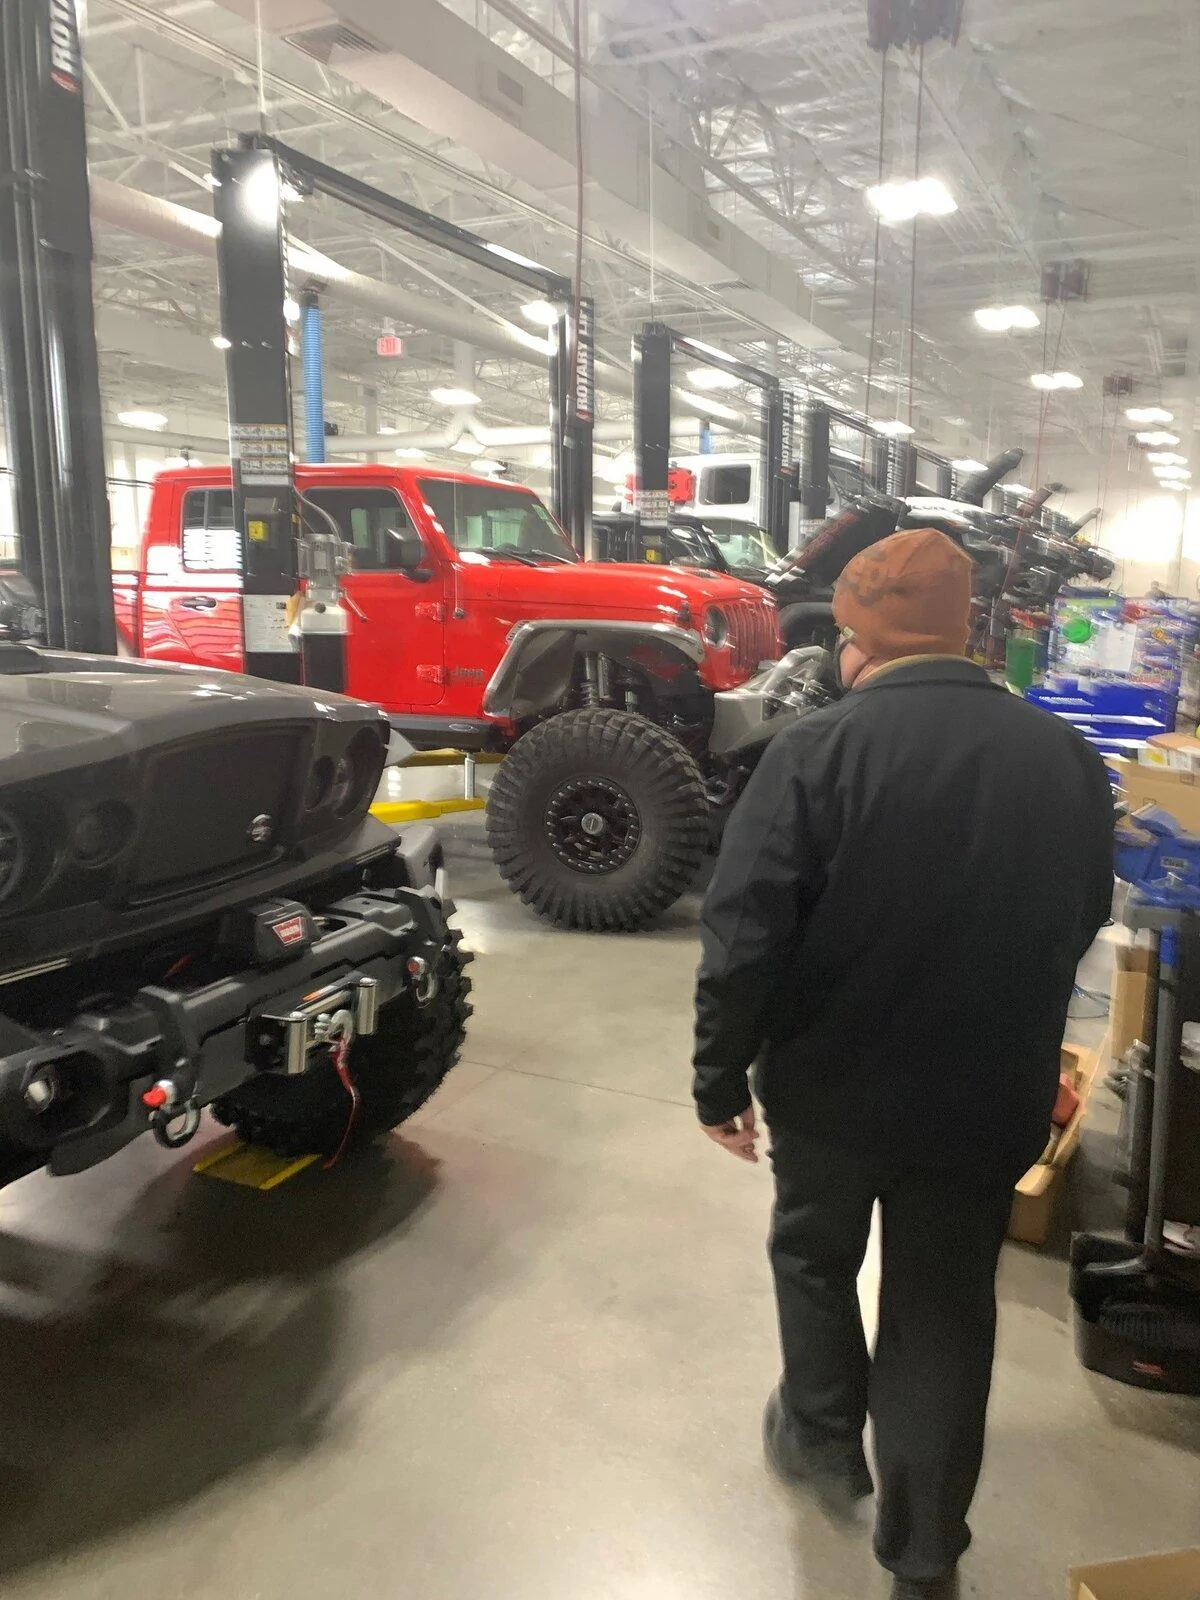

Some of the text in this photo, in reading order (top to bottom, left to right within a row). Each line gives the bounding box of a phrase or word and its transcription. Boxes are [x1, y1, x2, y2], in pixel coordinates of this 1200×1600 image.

[576, 341, 588, 411] ROTARY
[781, 391, 790, 467] ROTARY LIFT
